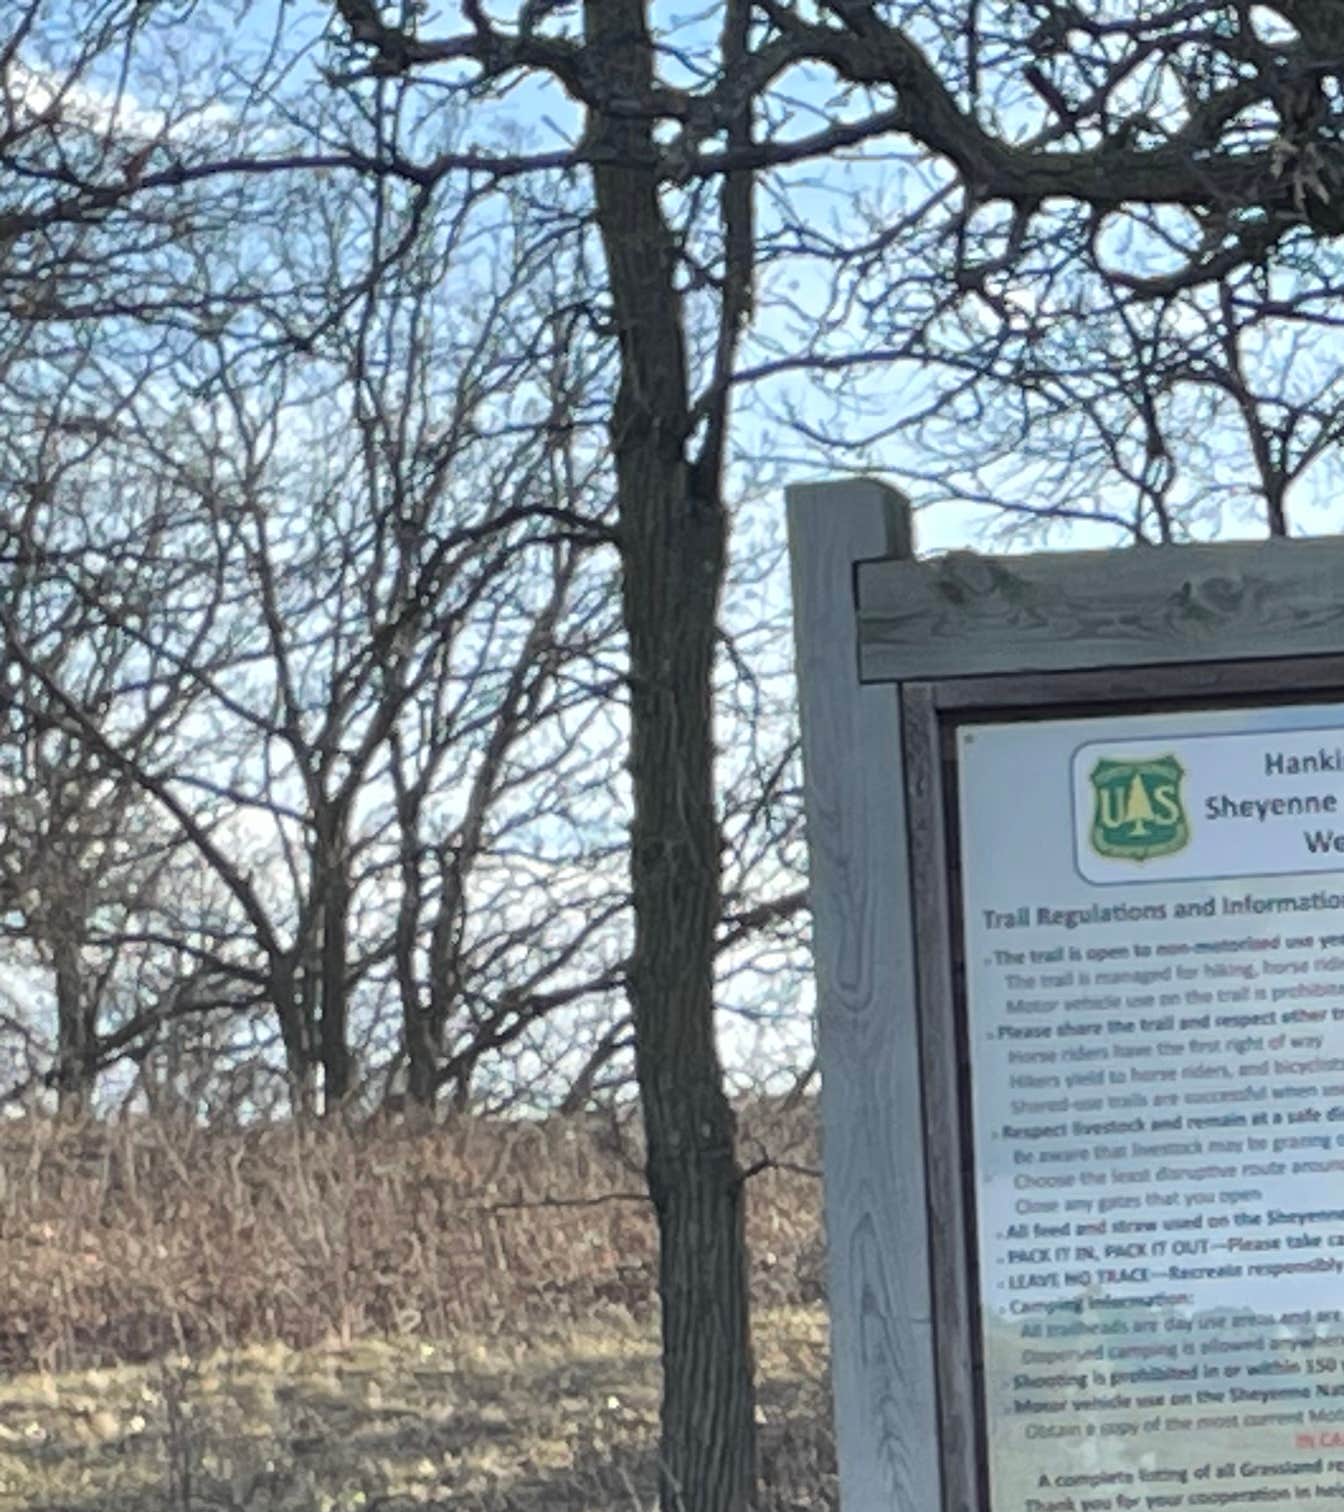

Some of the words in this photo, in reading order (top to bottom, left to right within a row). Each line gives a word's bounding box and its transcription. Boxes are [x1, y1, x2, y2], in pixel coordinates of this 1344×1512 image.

[1204, 788, 1337, 826] Sheyenne
[982, 908, 1030, 930] Trail
[1035, 900, 1167, 932] Regulations
[1172, 897, 1216, 919] and
